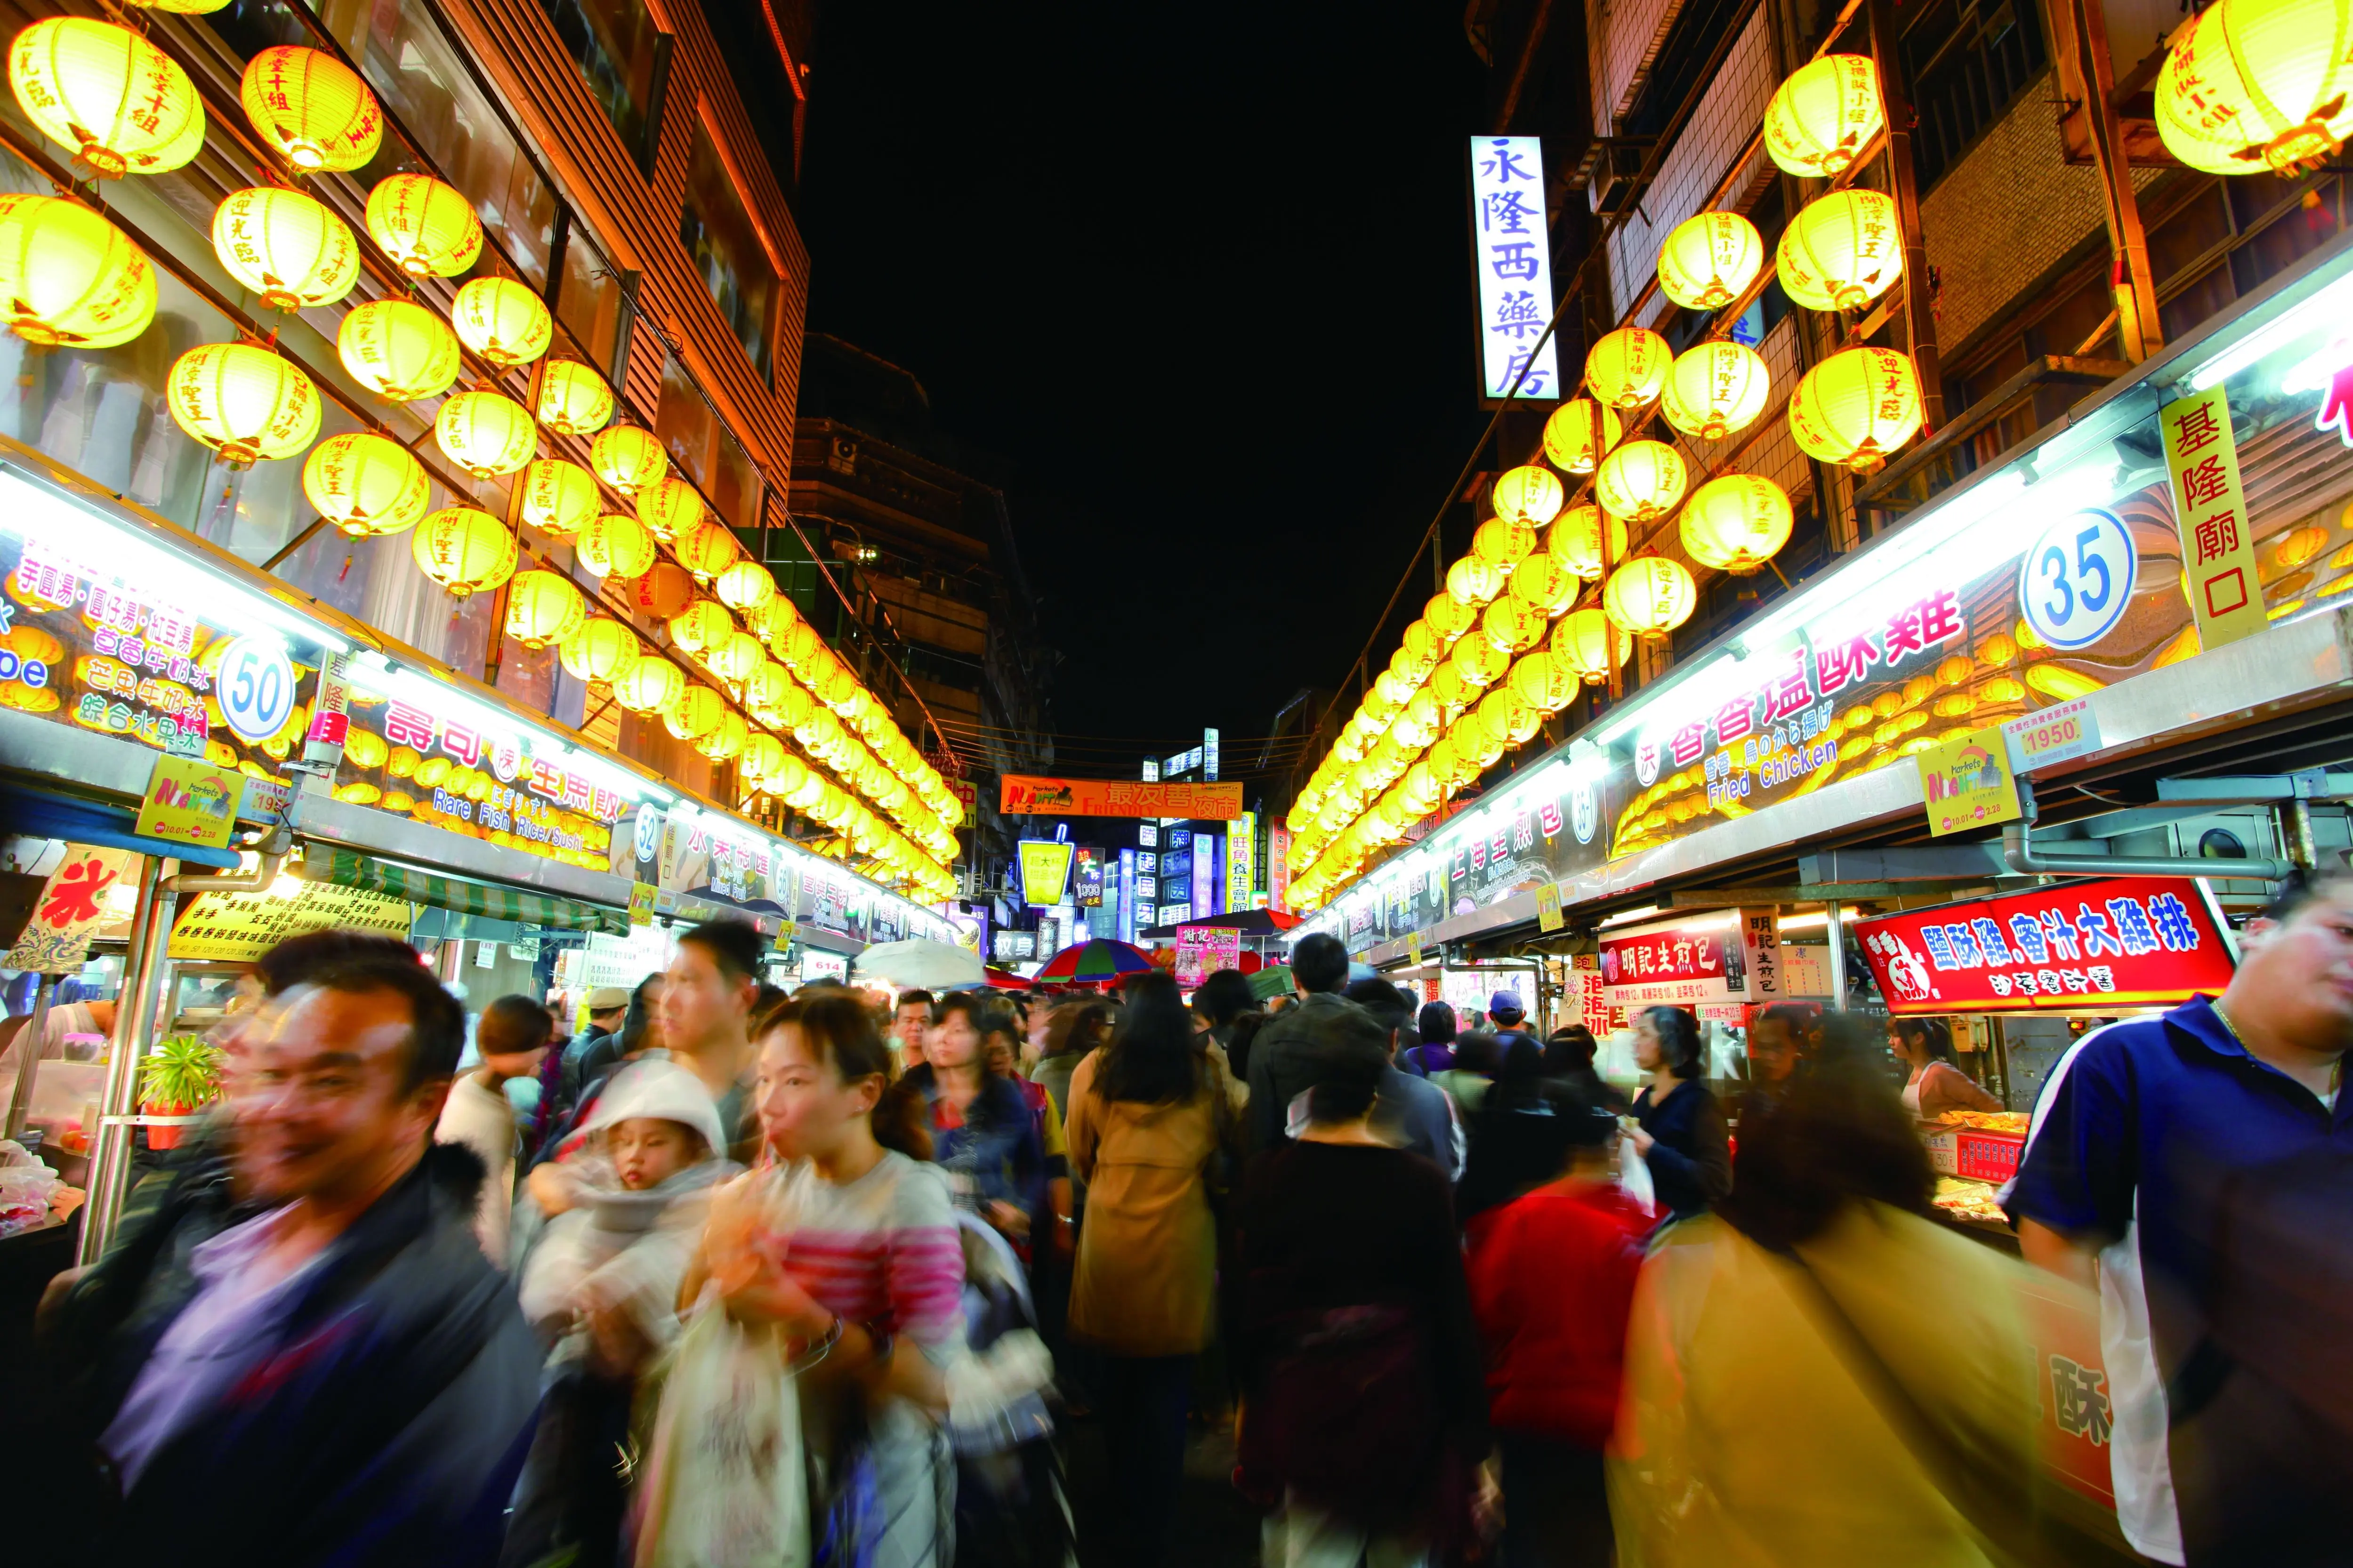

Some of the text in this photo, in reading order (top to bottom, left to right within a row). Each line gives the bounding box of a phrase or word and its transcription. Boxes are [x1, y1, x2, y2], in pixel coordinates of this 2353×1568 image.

[1858, 196, 1885, 258] 開漳聖王
[1479, 138, 1549, 395] 永隆西藥房
[1718, 349, 1739, 402] 開漳聖王
[2173, 401, 2248, 618] 基隆廟口
[2041, 525, 2111, 627] 35
[89, 660, 206, 721] 芒果牛奶冰
[232, 651, 281, 723] 50
[78, 694, 198, 750] 綜合水果冰
[387, 699, 481, 767] 壽司
[2027, 720, 2075, 752] 1950
[188, 783, 219, 798] Markets
[530, 758, 618, 822] 生魚飯
[1708, 740, 1837, 807] Fried Chicken
[1951, 760, 1981, 775] Markets
[258, 795, 283, 813] 195
[434, 788, 583, 852] Rare Fish Rice/Sushi
[1108, 781, 1192, 808] 最友善
[1194, 796, 1237, 819] 夜市
[1952, 814, 1969, 826] 10.01
[1986, 804, 2001, 816] 2.28
[166, 826, 184, 835] 10.01
[639, 815, 654, 851] 52
[1452, 797, 1562, 879] 上海生煎包
[710, 876, 747, 901] Mixed Fruit
[1076, 882, 1101, 899] 1000
[1232, 837, 1248, 913] 旺角養生會館
[994, 936, 1034, 957] 紋身
[1183, 928, 1210, 942] 謝記
[1621, 935, 1716, 978] 明記生煎包
[1750, 916, 1777, 992] 明記生煎包
[815, 961, 840, 971] 614
[1576, 956, 1591, 969] 泡
[1583, 974, 1610, 1037] 泡泡冰
[2049, 1354, 2112, 1447] 酥
